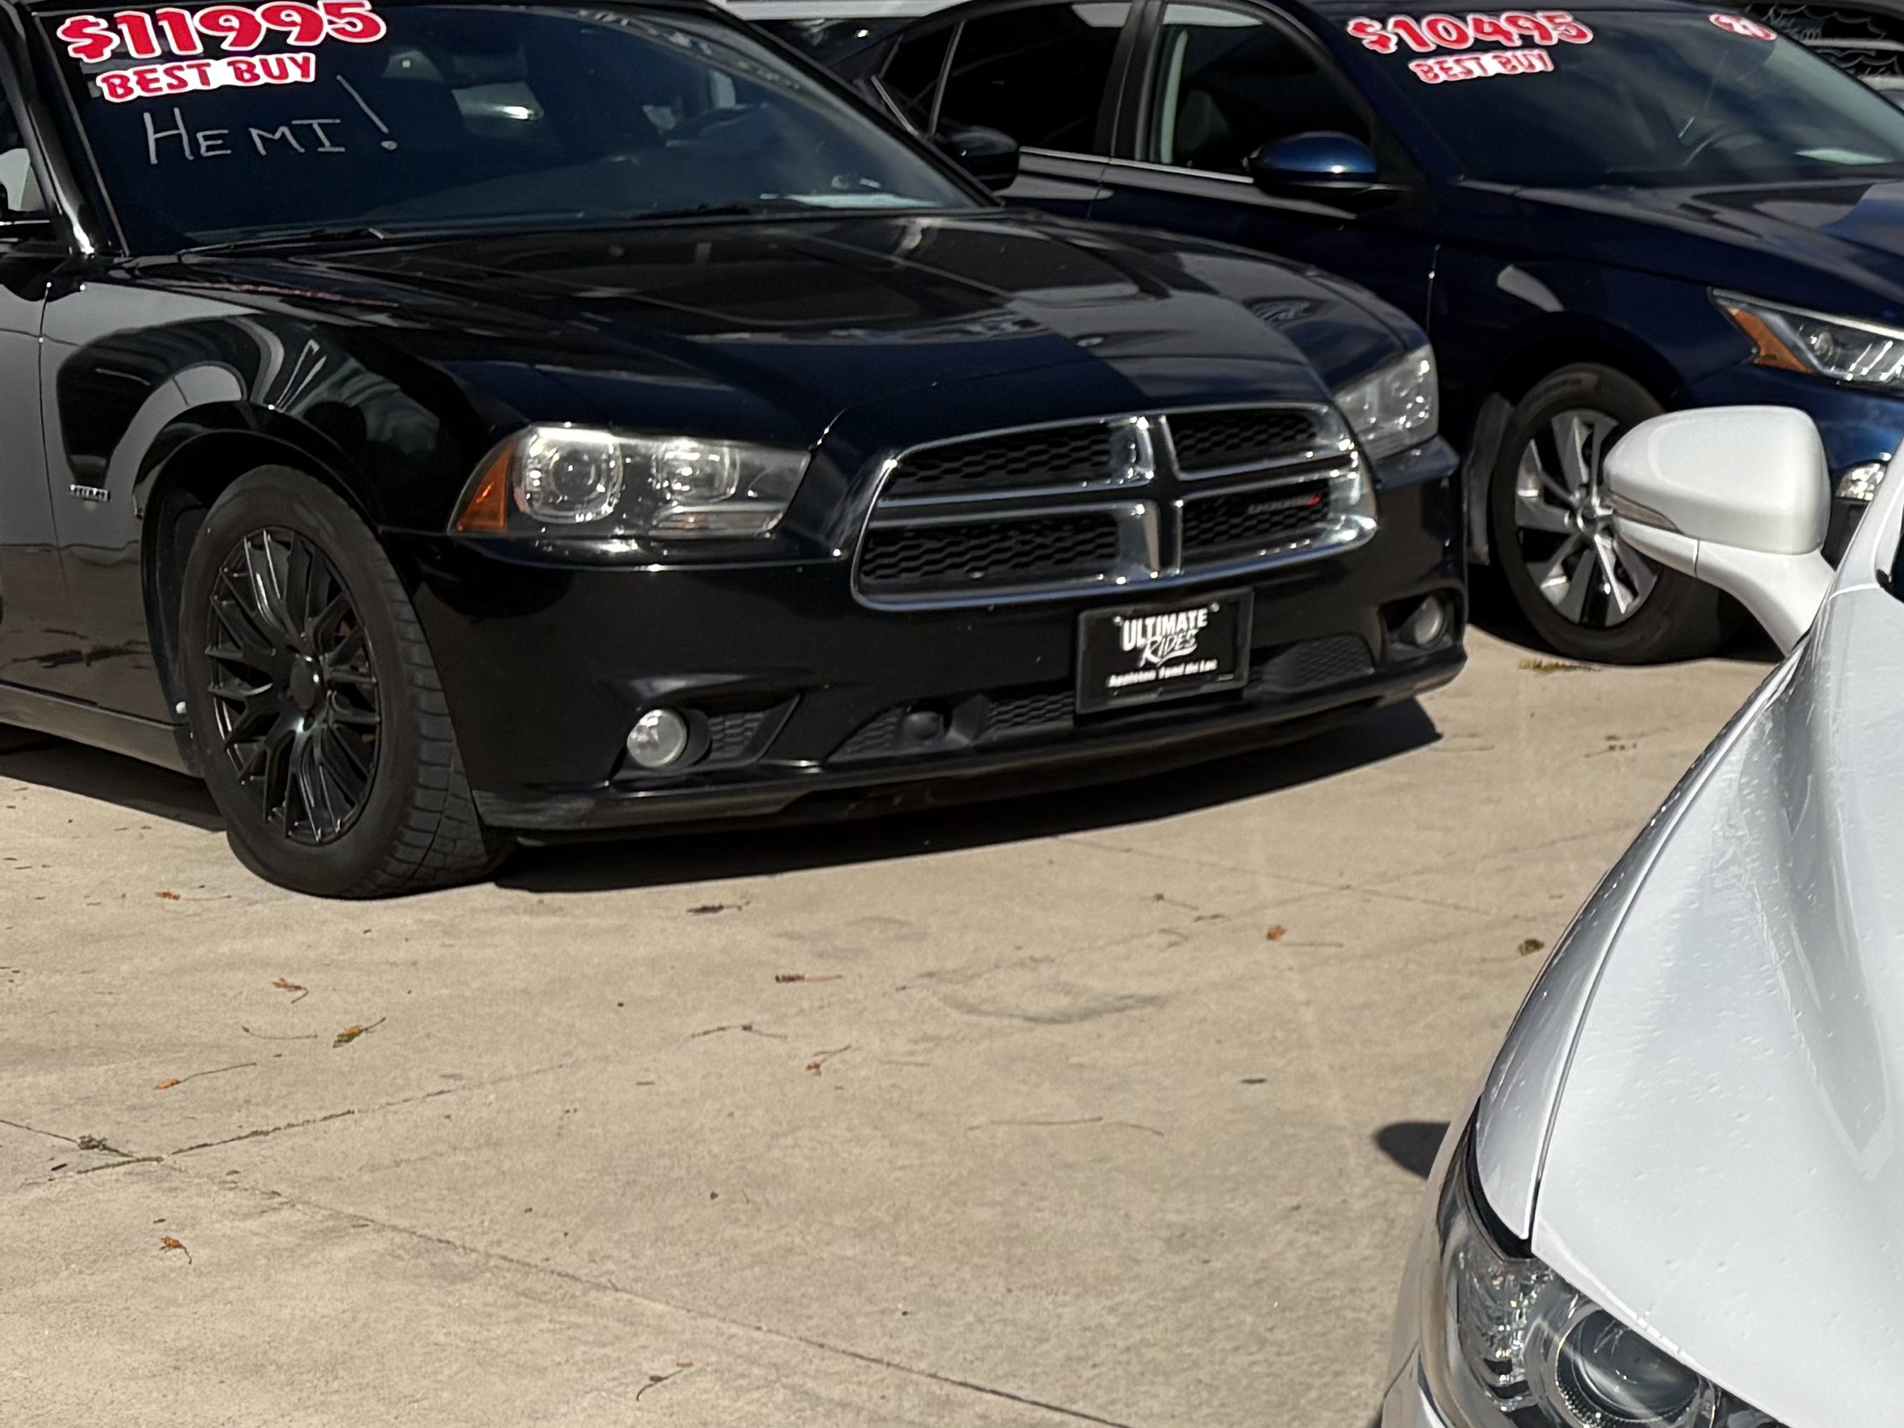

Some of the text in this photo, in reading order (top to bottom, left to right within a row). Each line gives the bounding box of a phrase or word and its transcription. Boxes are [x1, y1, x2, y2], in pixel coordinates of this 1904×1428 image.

[57, 0, 386, 63] $11995
[1346, 11, 1594, 53] $10495
[101, 54, 315, 101] BEST BUY
[1411, 50, 1553, 83] BEST BUY
[1122, 608, 1208, 651] ULTIMATE
